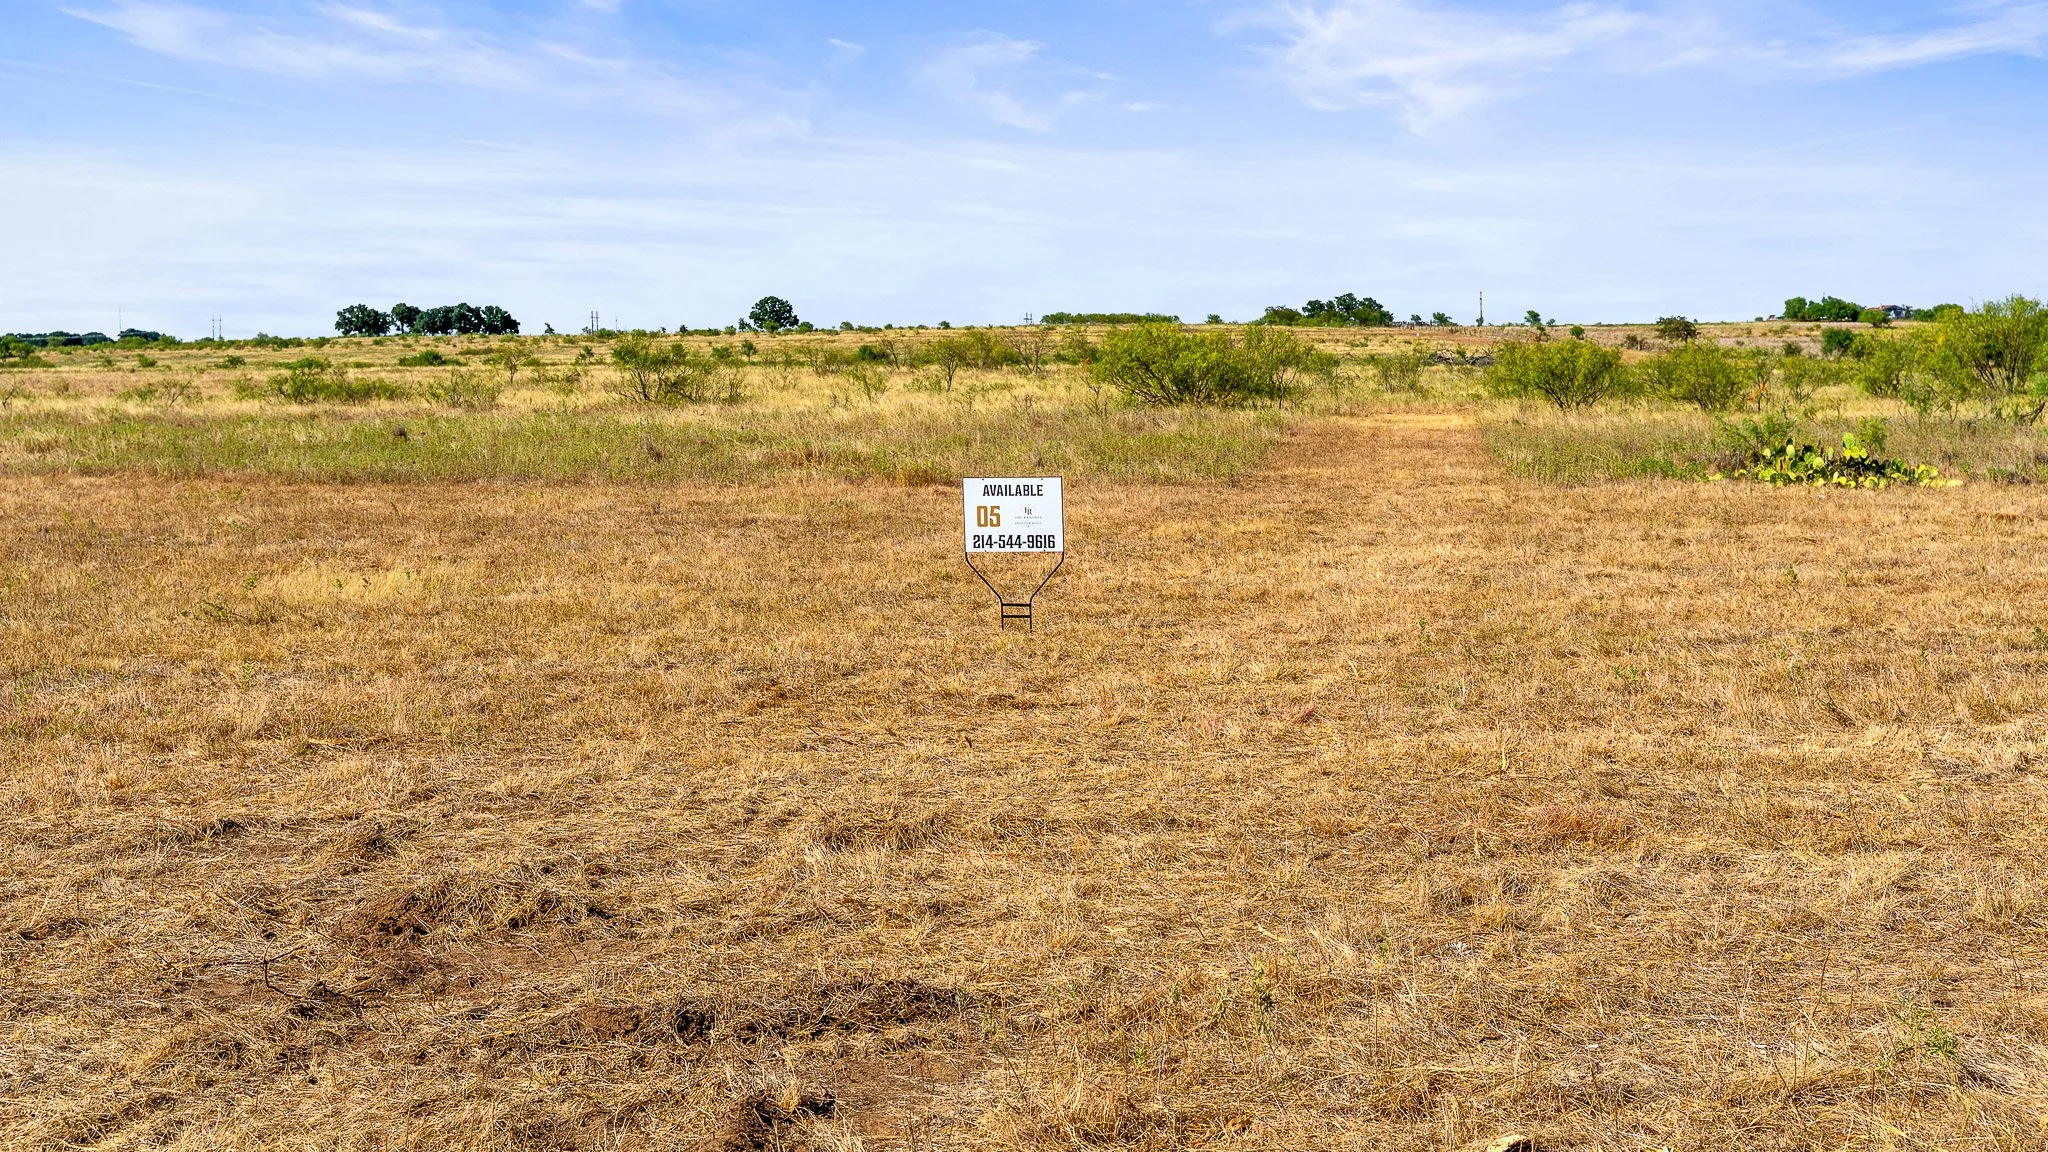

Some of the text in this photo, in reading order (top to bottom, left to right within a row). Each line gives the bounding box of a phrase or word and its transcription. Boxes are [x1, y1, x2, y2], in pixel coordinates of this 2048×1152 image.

[982, 484, 1044, 497] AVAILABLE
[976, 505, 1001, 528] 05
[973, 534, 1056, 549] 214-544-9616
